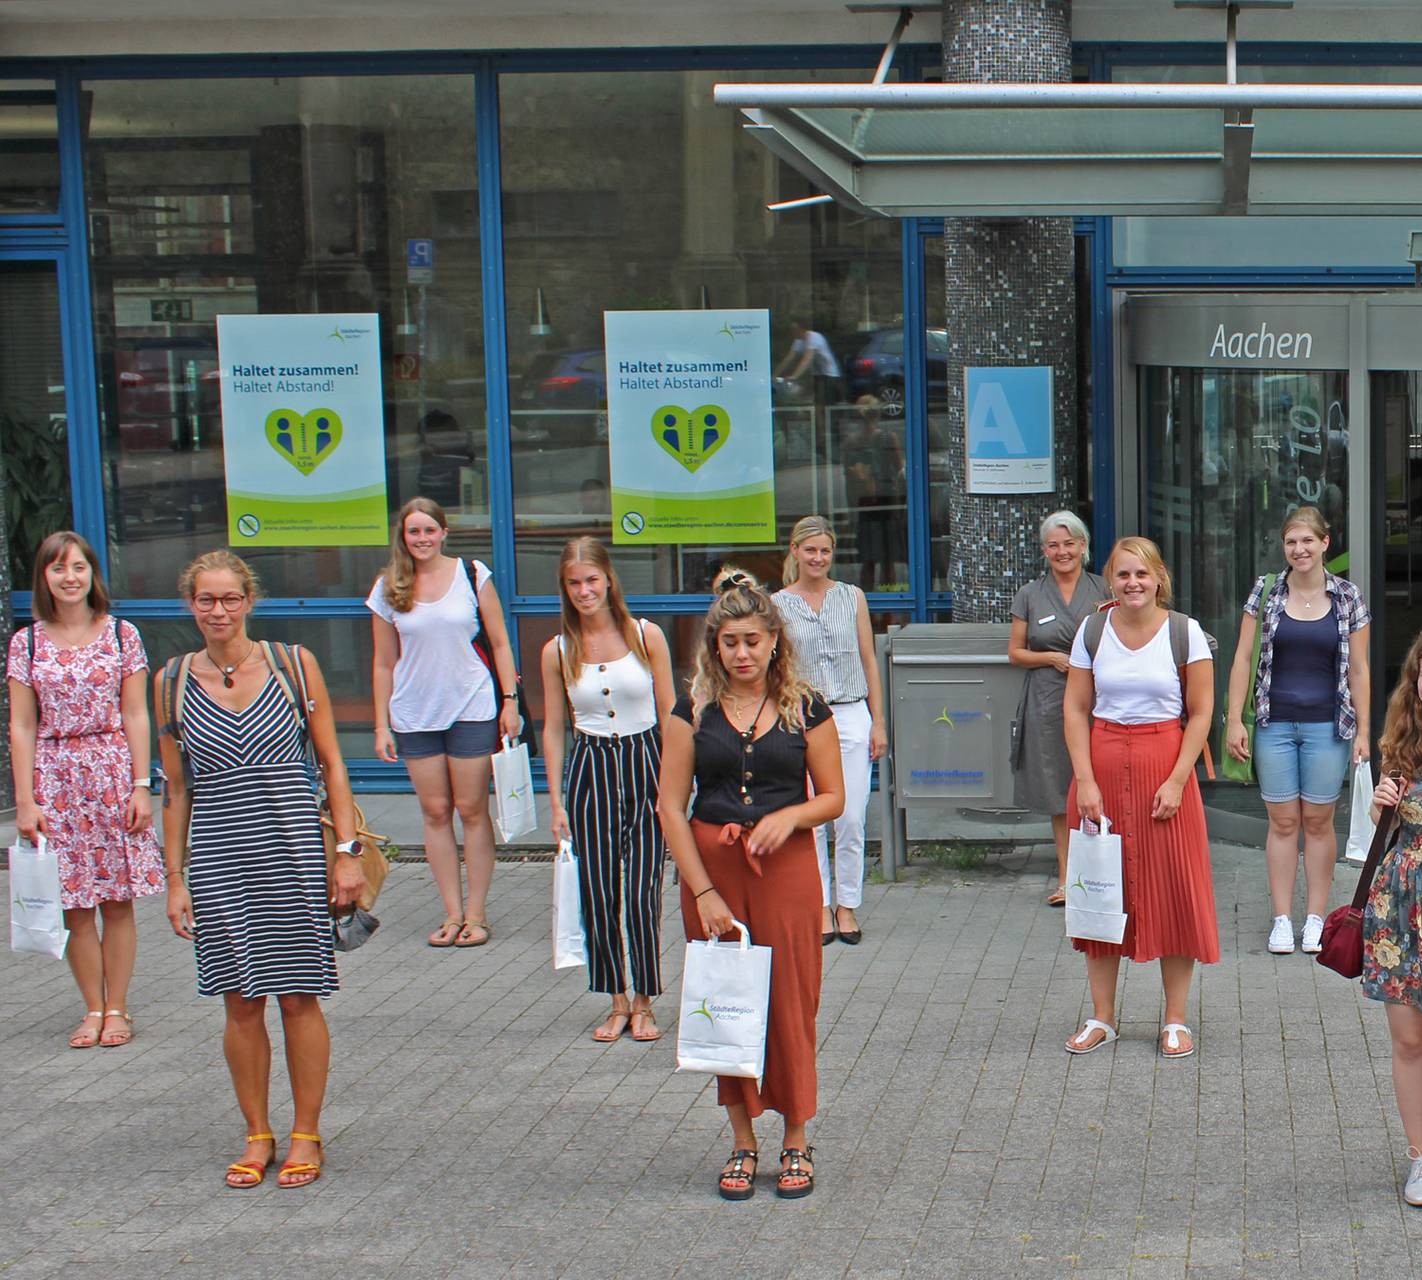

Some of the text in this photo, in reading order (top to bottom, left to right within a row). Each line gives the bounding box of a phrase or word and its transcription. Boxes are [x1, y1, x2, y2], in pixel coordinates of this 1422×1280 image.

[1210, 322, 1313, 359] Aachen
[233, 364, 358, 377] Haltet zusammen!
[619, 360, 748, 373] Haltet zusammen!
[233, 380, 334, 392] Haltet Abstand!
[620, 376, 723, 390] Haltet Abstand!
[969, 382, 1028, 453] A
[710, 1004, 754, 1016] StädteRegion
